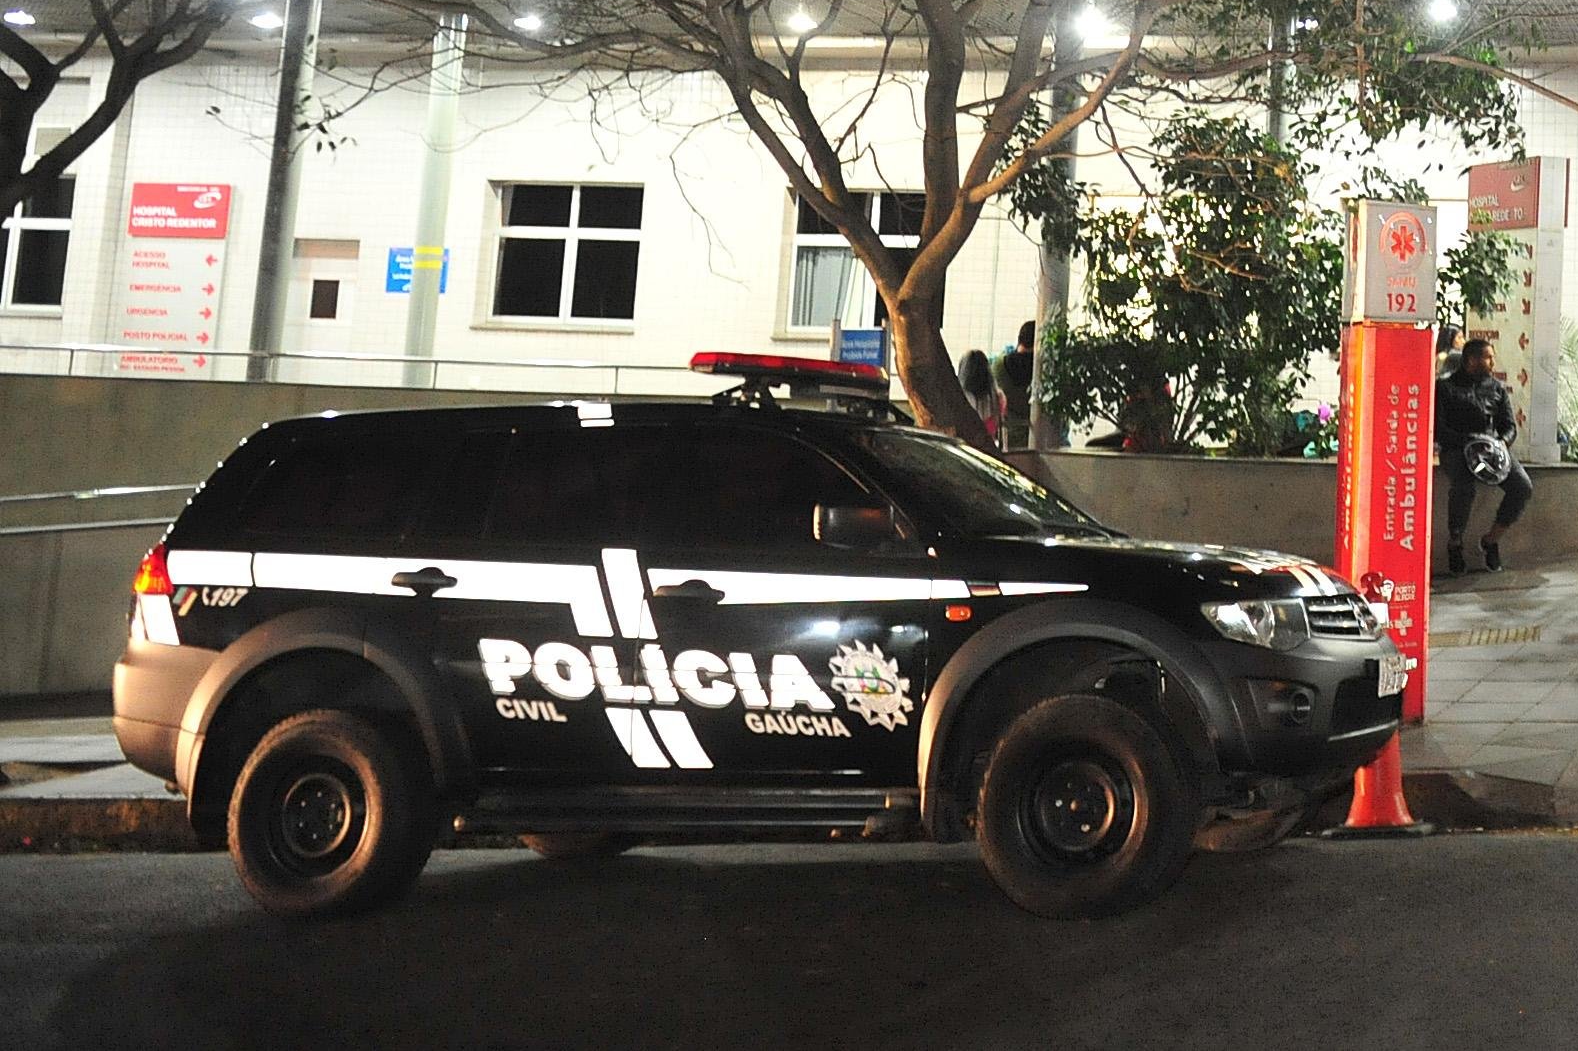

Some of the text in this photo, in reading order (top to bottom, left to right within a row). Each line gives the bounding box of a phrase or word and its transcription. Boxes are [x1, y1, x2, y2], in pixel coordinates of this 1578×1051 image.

[133, 205, 177, 217] HOSPITAL
[166, 218, 217, 229] REDENTOR
[1386, 292, 1417, 313] 192
[1386, 383, 1401, 406] de
[1400, 383, 1420, 551] Ambulâncias
[1384, 476, 1397, 541] Entrada
[210, 587, 249, 607] 197
[479, 638, 836, 712] POLÍCIA
[496, 697, 569, 723] CIVIL
[744, 710, 853, 738] GAÚCHA
